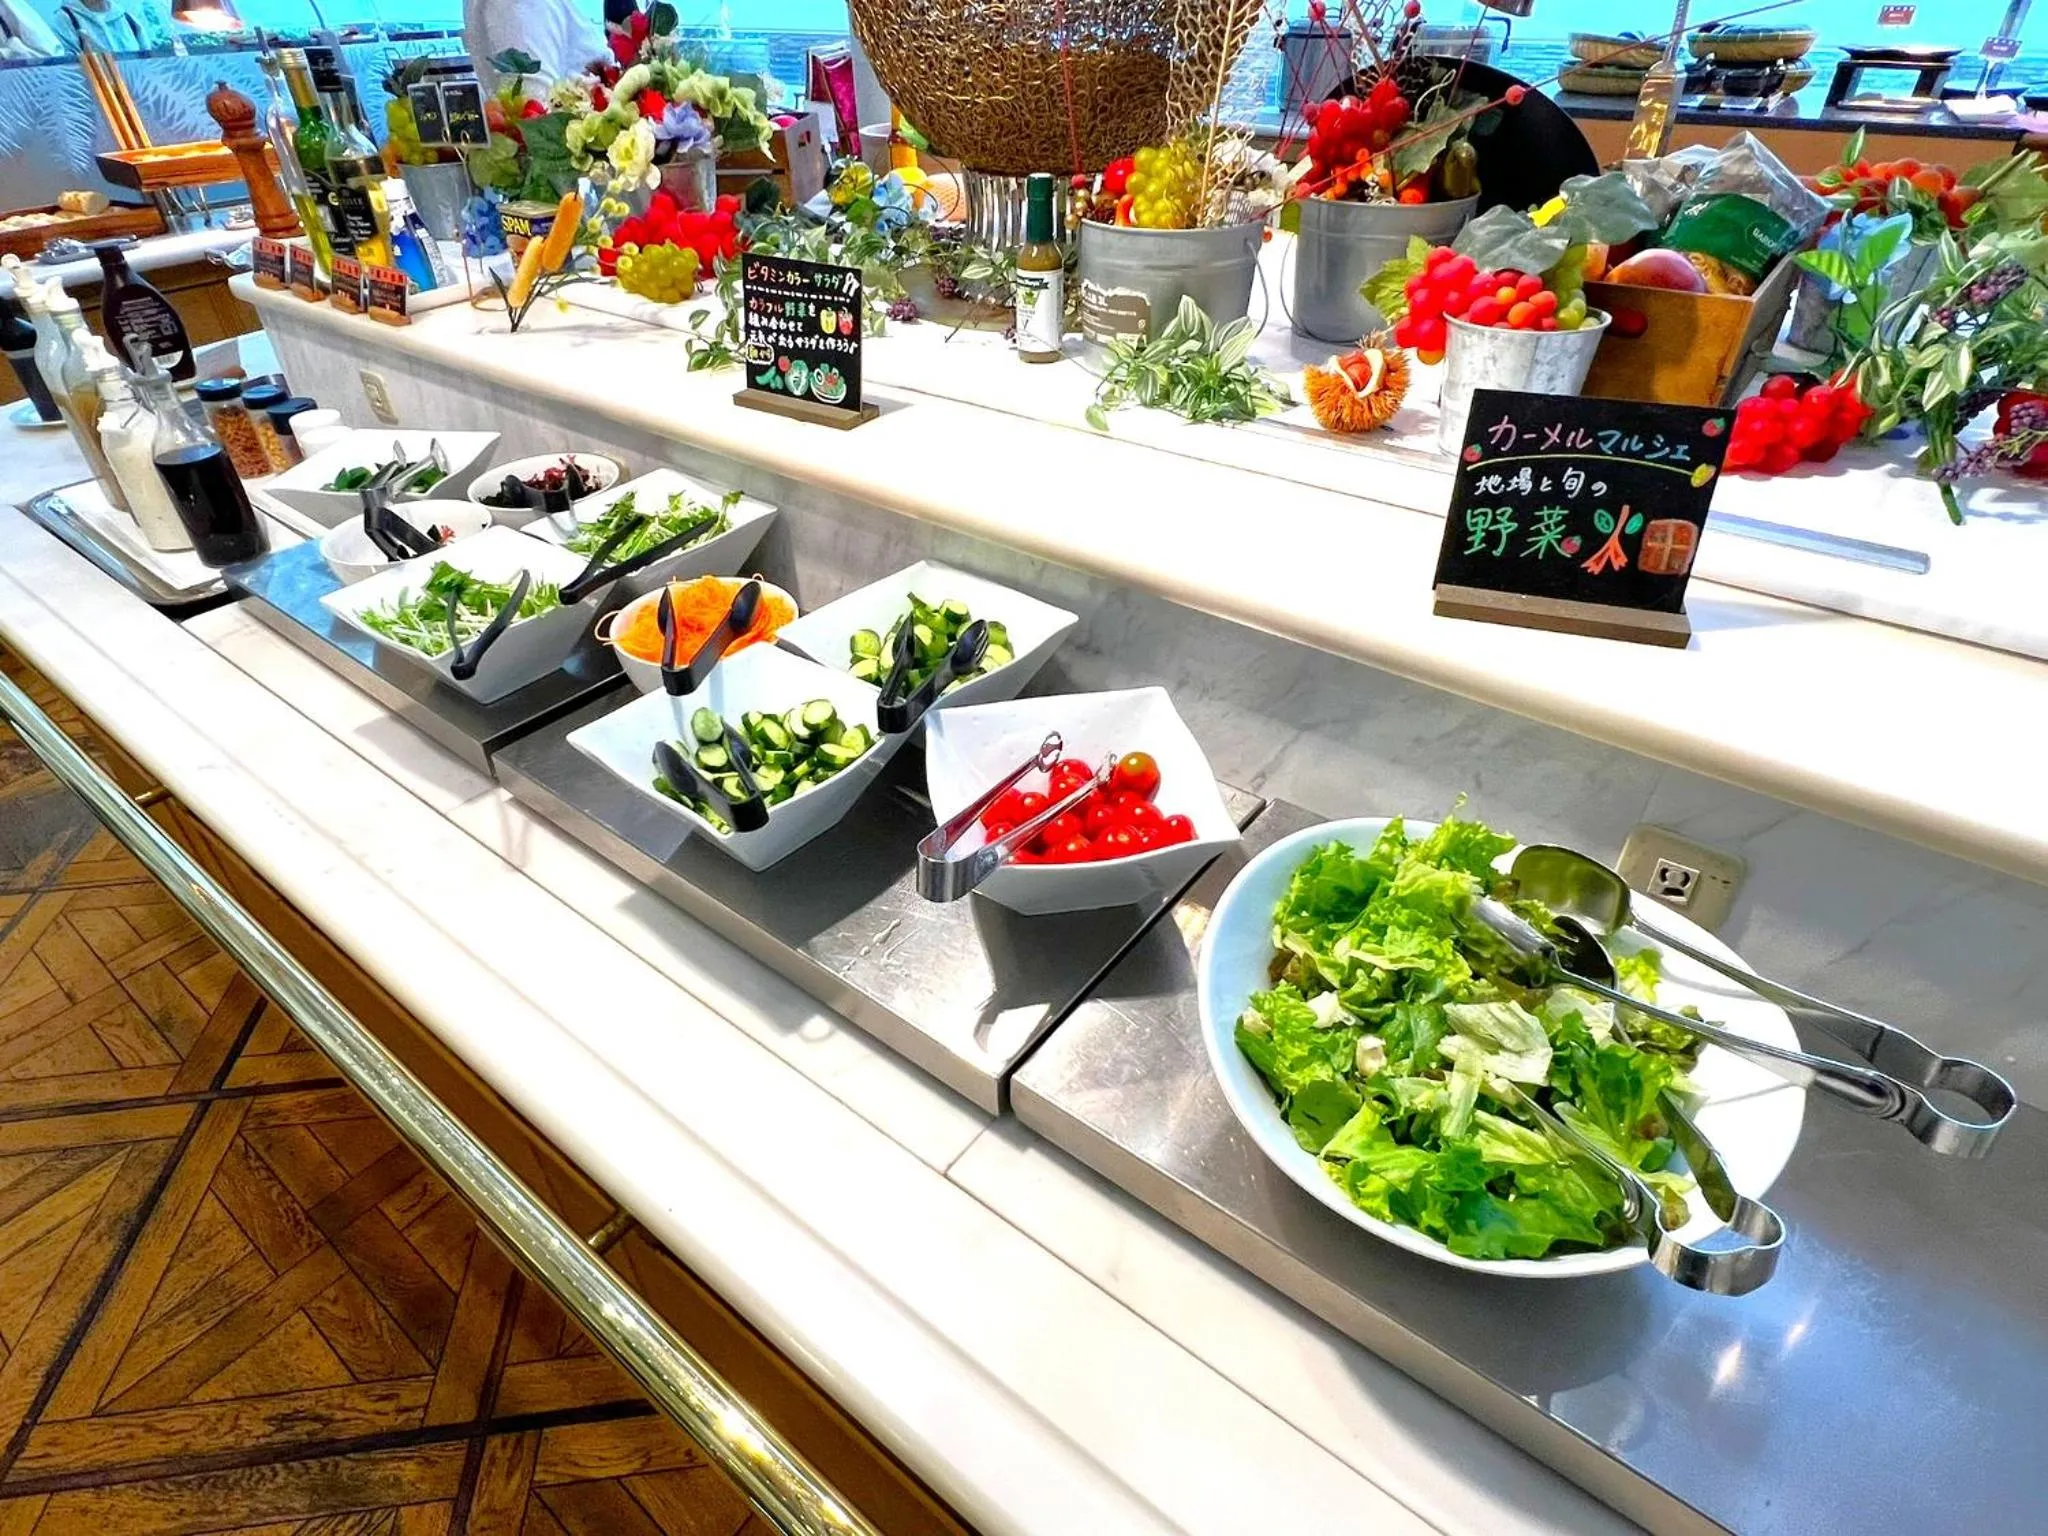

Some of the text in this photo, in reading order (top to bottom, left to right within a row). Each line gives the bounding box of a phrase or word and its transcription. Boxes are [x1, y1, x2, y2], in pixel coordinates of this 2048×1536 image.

[501, 214, 532, 236] SPAM
[1488, 415, 1691, 461] カーメルマルシェ
[1474, 466, 1608, 499] 地場と旬の
